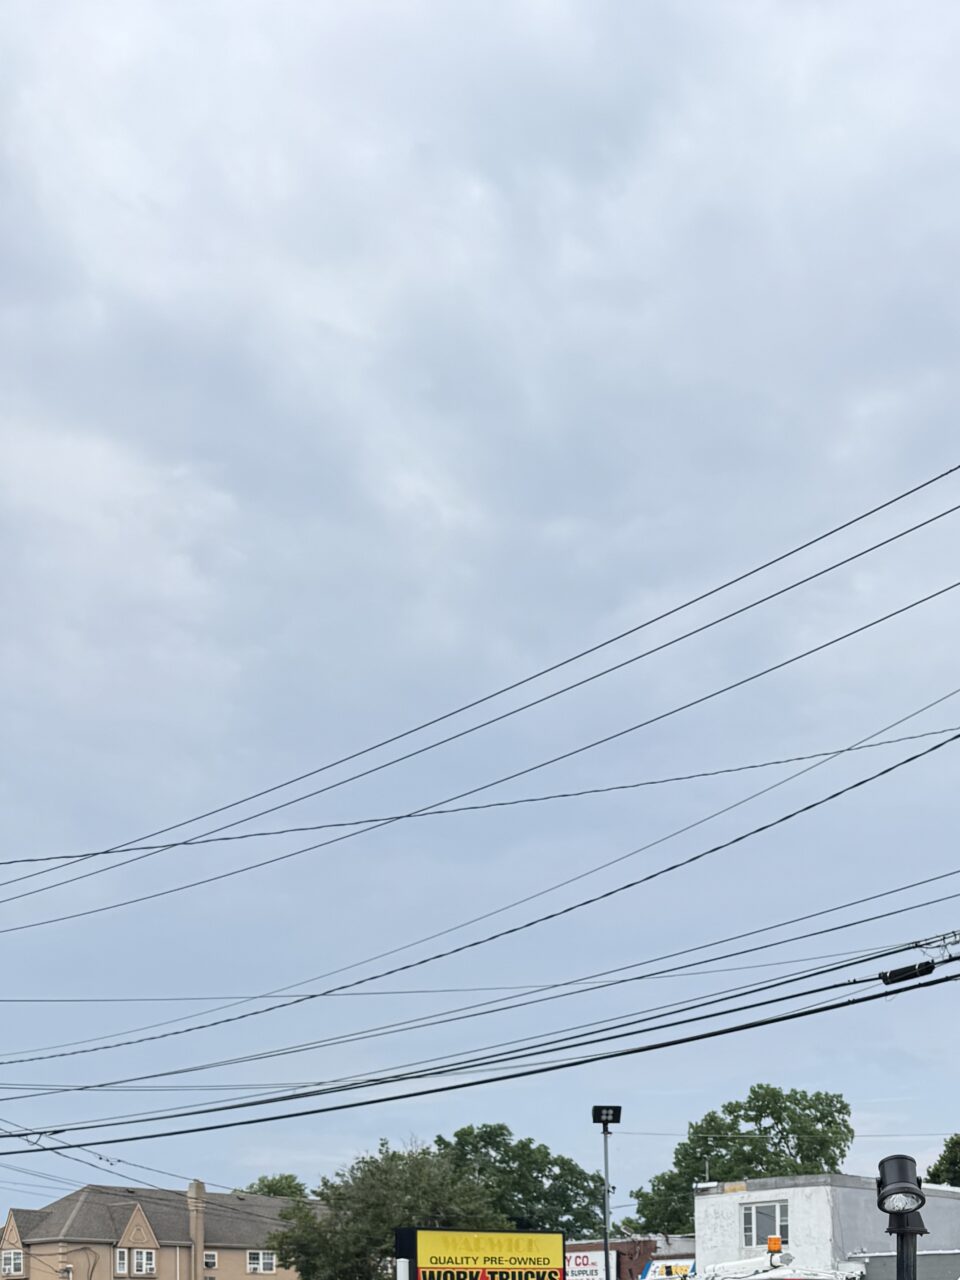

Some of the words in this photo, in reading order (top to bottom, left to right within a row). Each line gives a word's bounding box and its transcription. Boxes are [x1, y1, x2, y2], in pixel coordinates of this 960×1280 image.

[442, 1236, 541, 1253] WARWICK
[429, 1255, 479, 1266] QUALITY
[483, 1256, 551, 1266] PRE-OWNED
